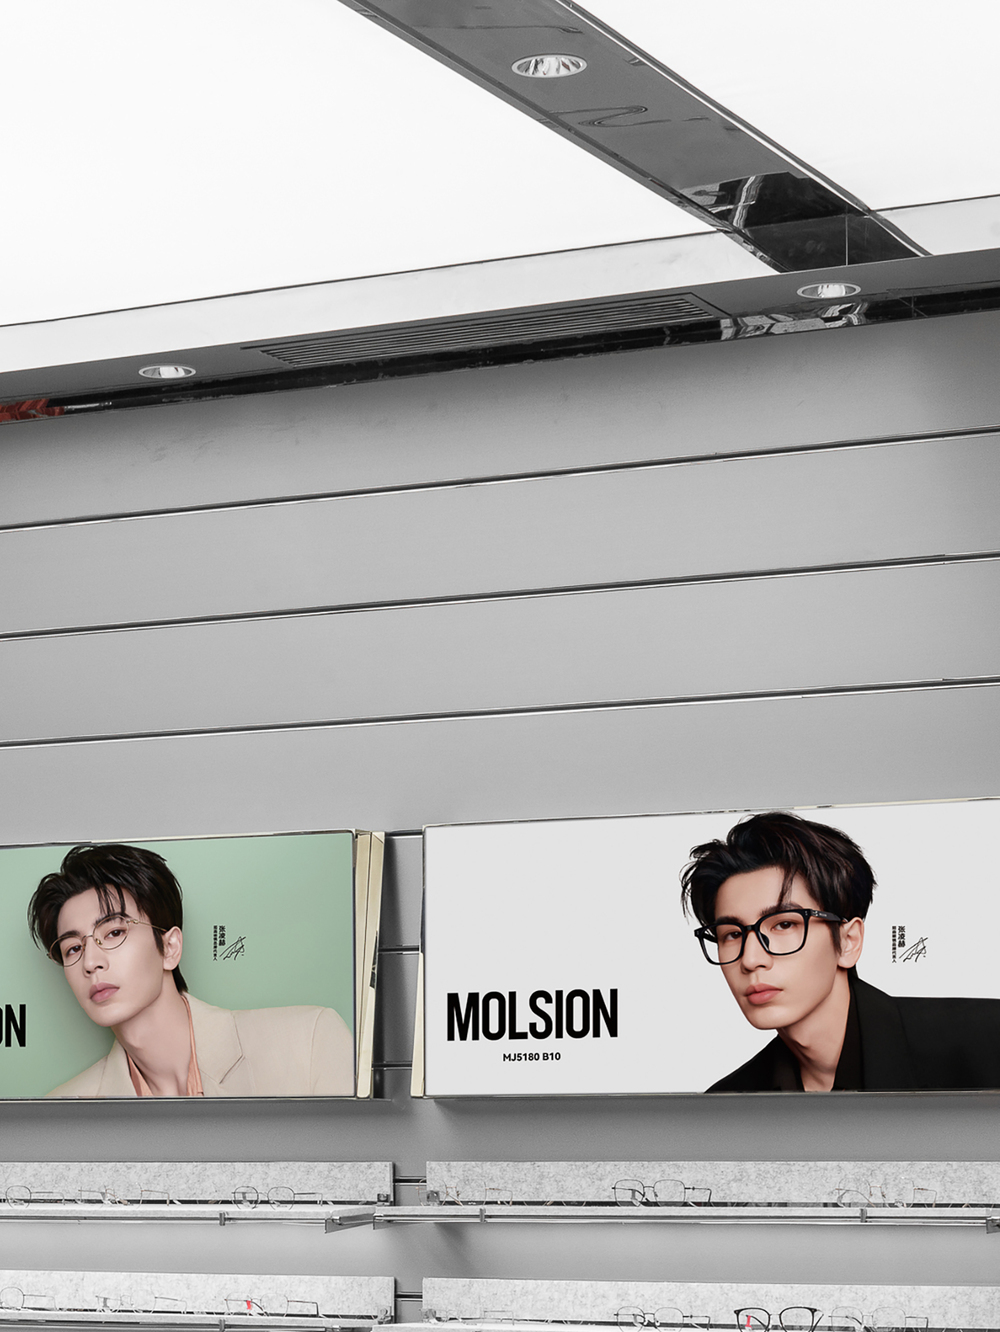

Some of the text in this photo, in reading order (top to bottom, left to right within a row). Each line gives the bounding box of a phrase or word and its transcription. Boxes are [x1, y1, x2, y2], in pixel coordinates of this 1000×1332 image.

[446, 988, 618, 1042] MOLSION
[502, 1051, 562, 1062] MJ5180 B10
